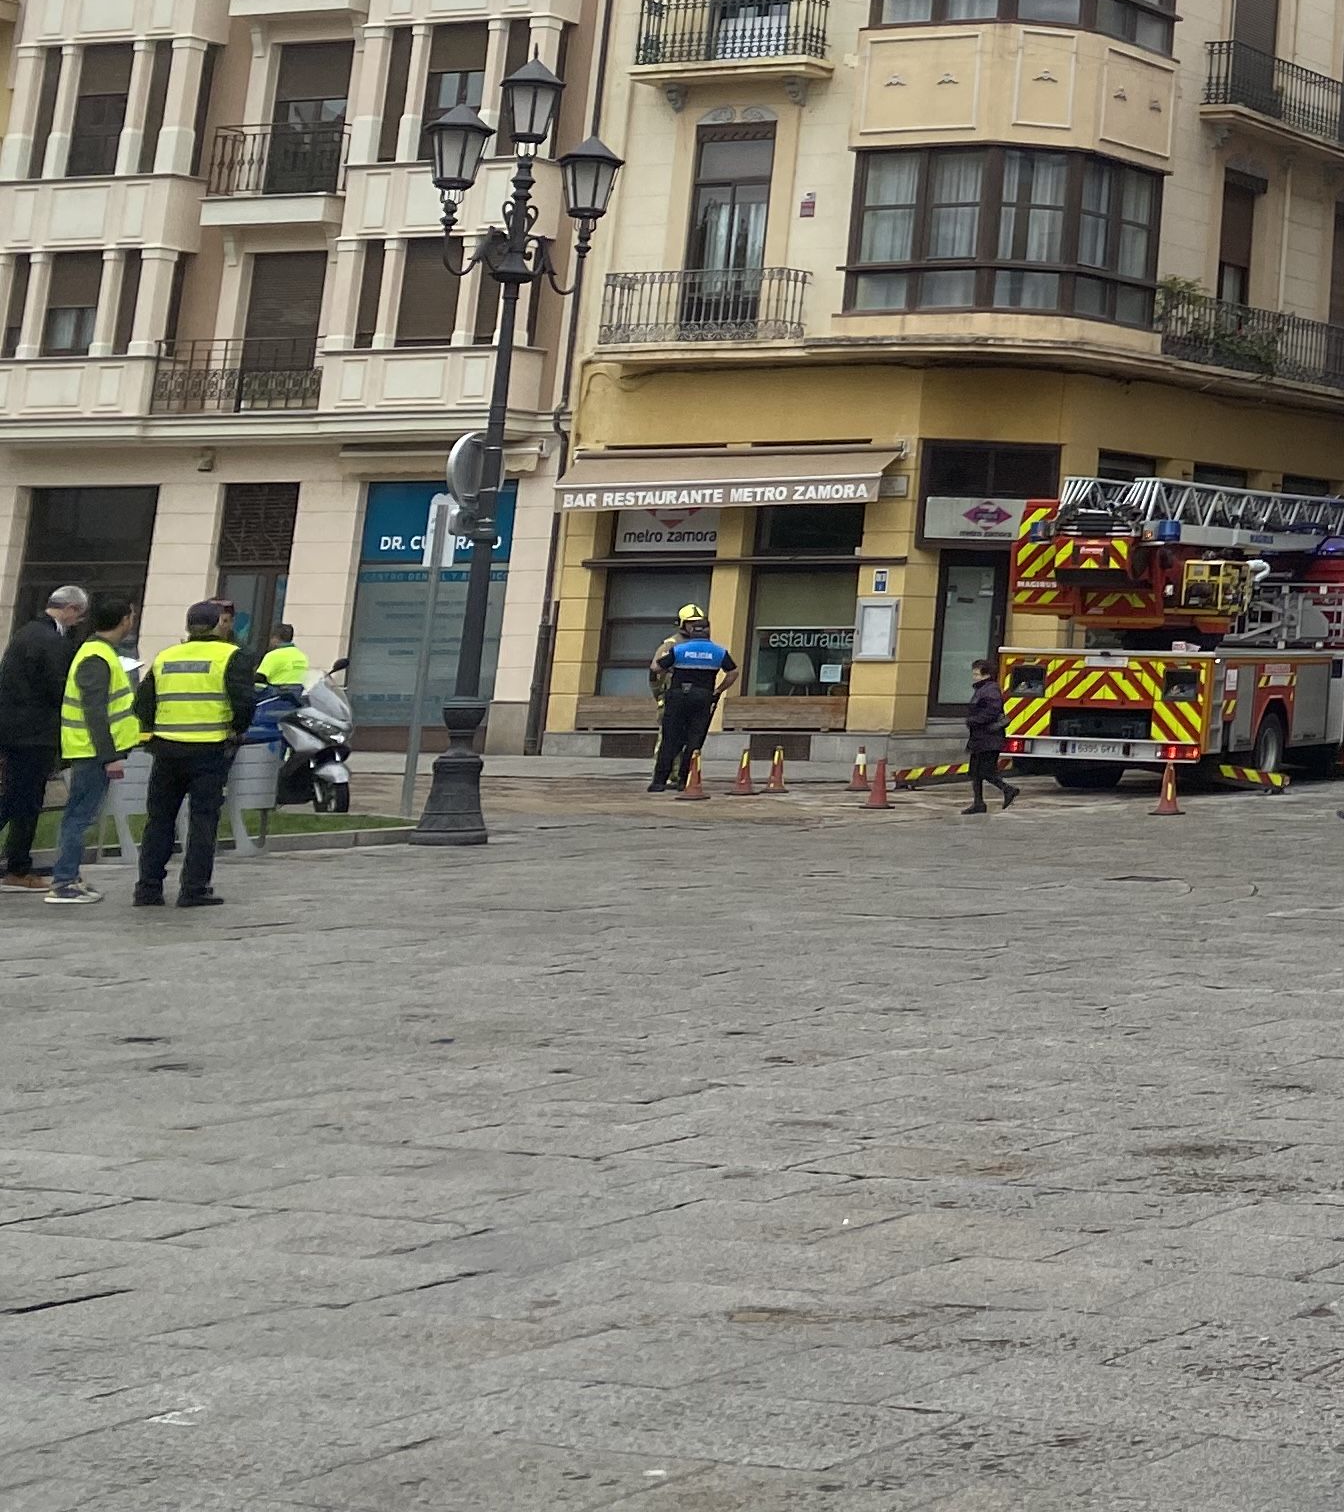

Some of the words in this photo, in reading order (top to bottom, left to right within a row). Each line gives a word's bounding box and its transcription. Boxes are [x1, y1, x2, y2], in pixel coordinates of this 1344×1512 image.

[563, 492, 597, 508] BAR
[602, 488, 724, 507] RESTAURANTE
[729, 486, 787, 503] METRO
[792, 483, 868, 501] ZAMORA
[380, 536, 405, 550] DR.
[623, 529, 663, 543] metro
[667, 530, 717, 543] zamora
[1017, 580, 1057, 588] MAGIRUS
